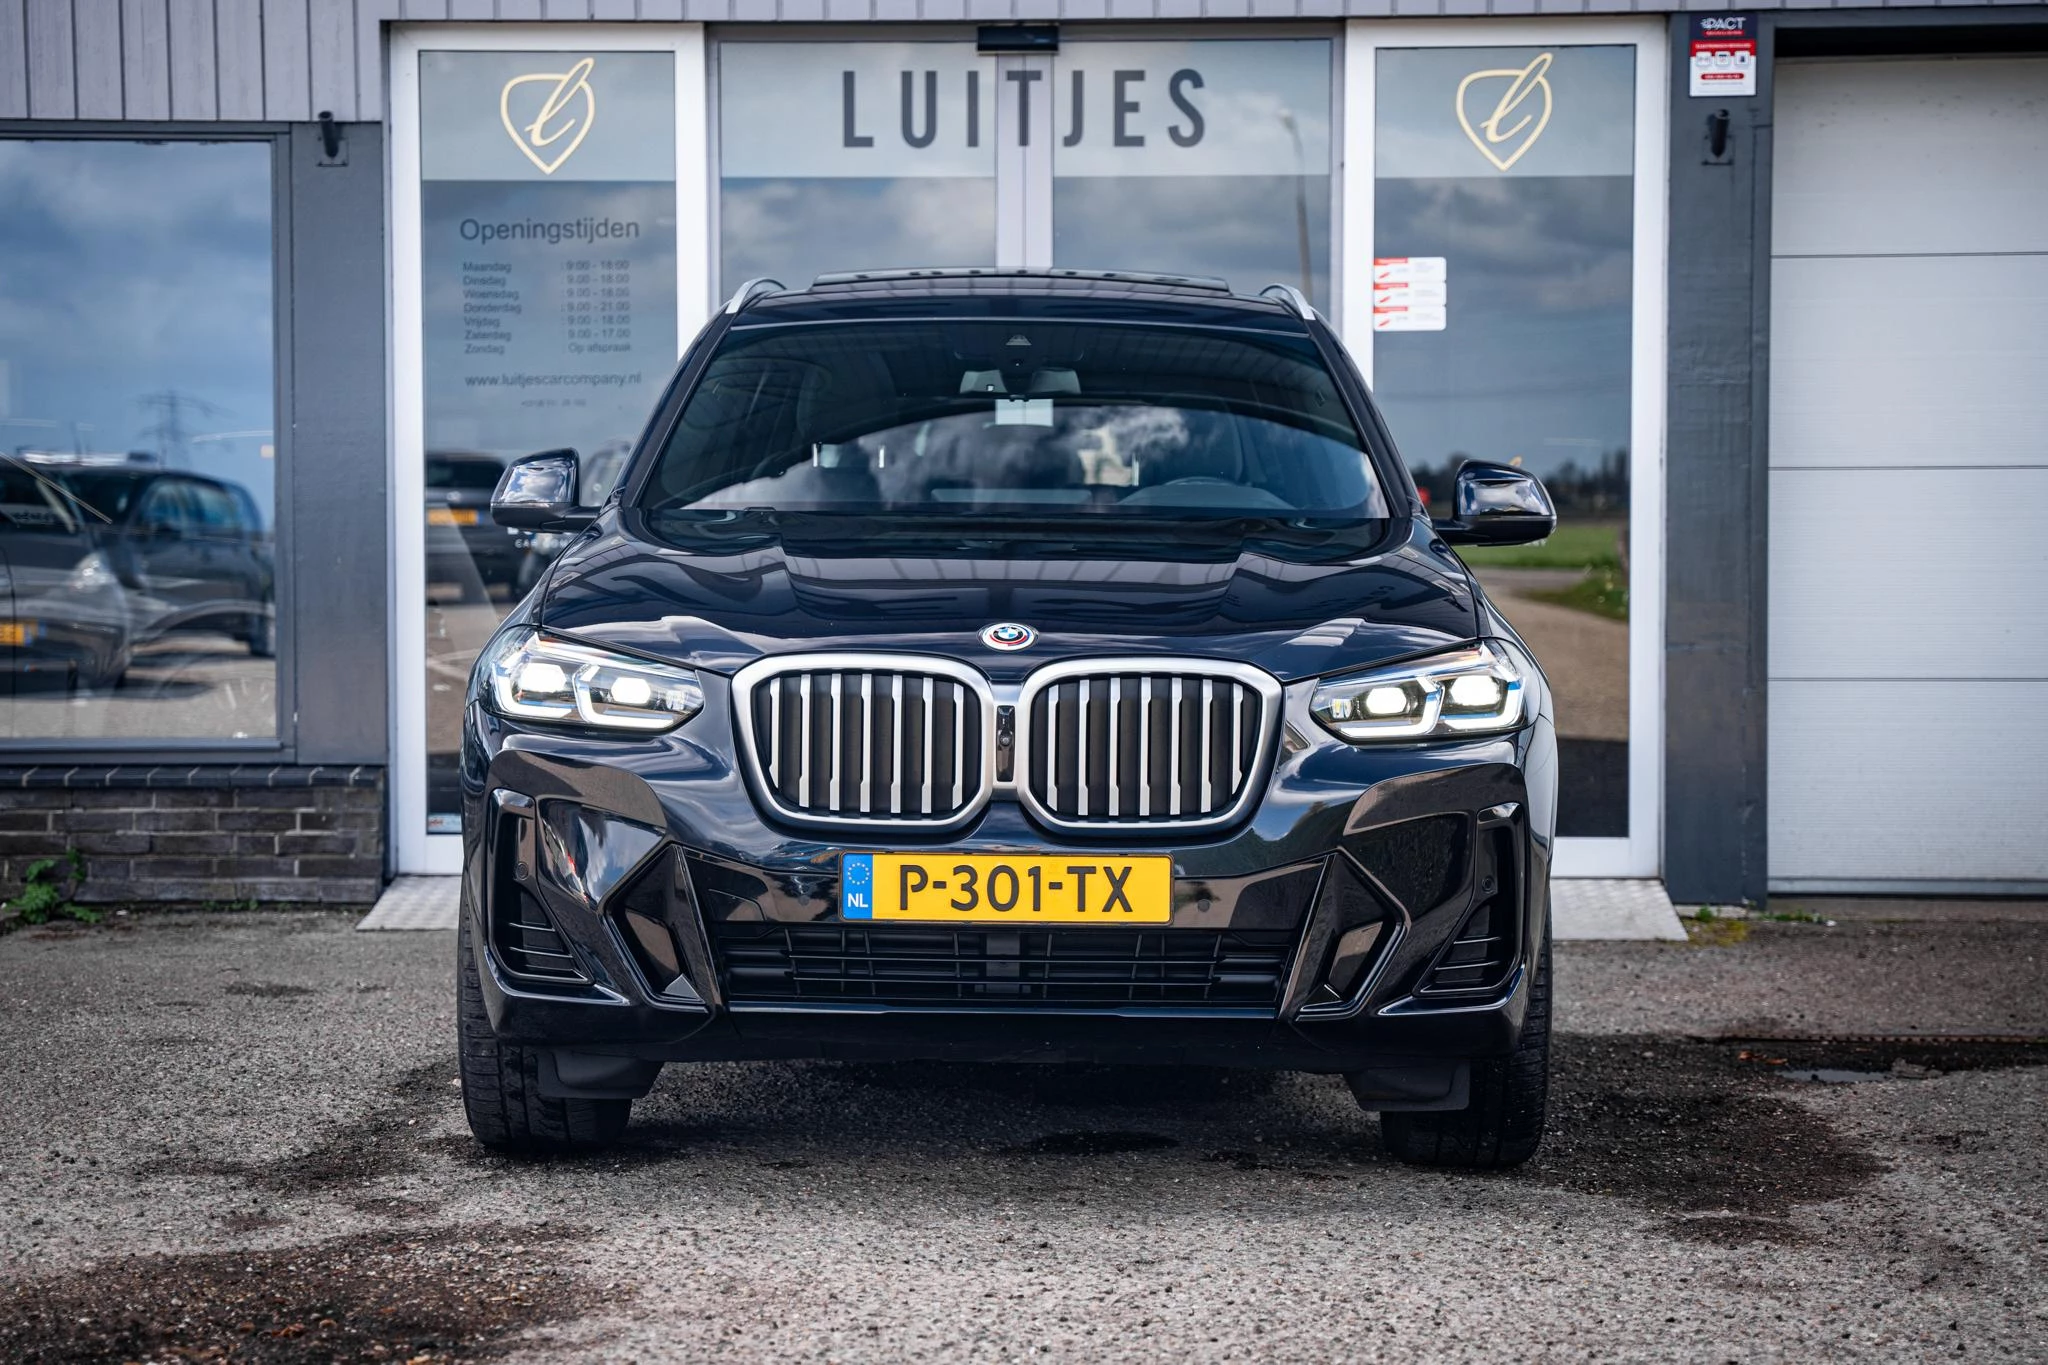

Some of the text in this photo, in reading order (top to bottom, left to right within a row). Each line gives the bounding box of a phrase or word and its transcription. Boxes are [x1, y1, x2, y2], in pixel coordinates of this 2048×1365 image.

[843, 68, 1205, 148] LUITJES
[460, 217, 640, 245] Openingstijden
[847, 864, 1133, 912] NL P-301-TX
